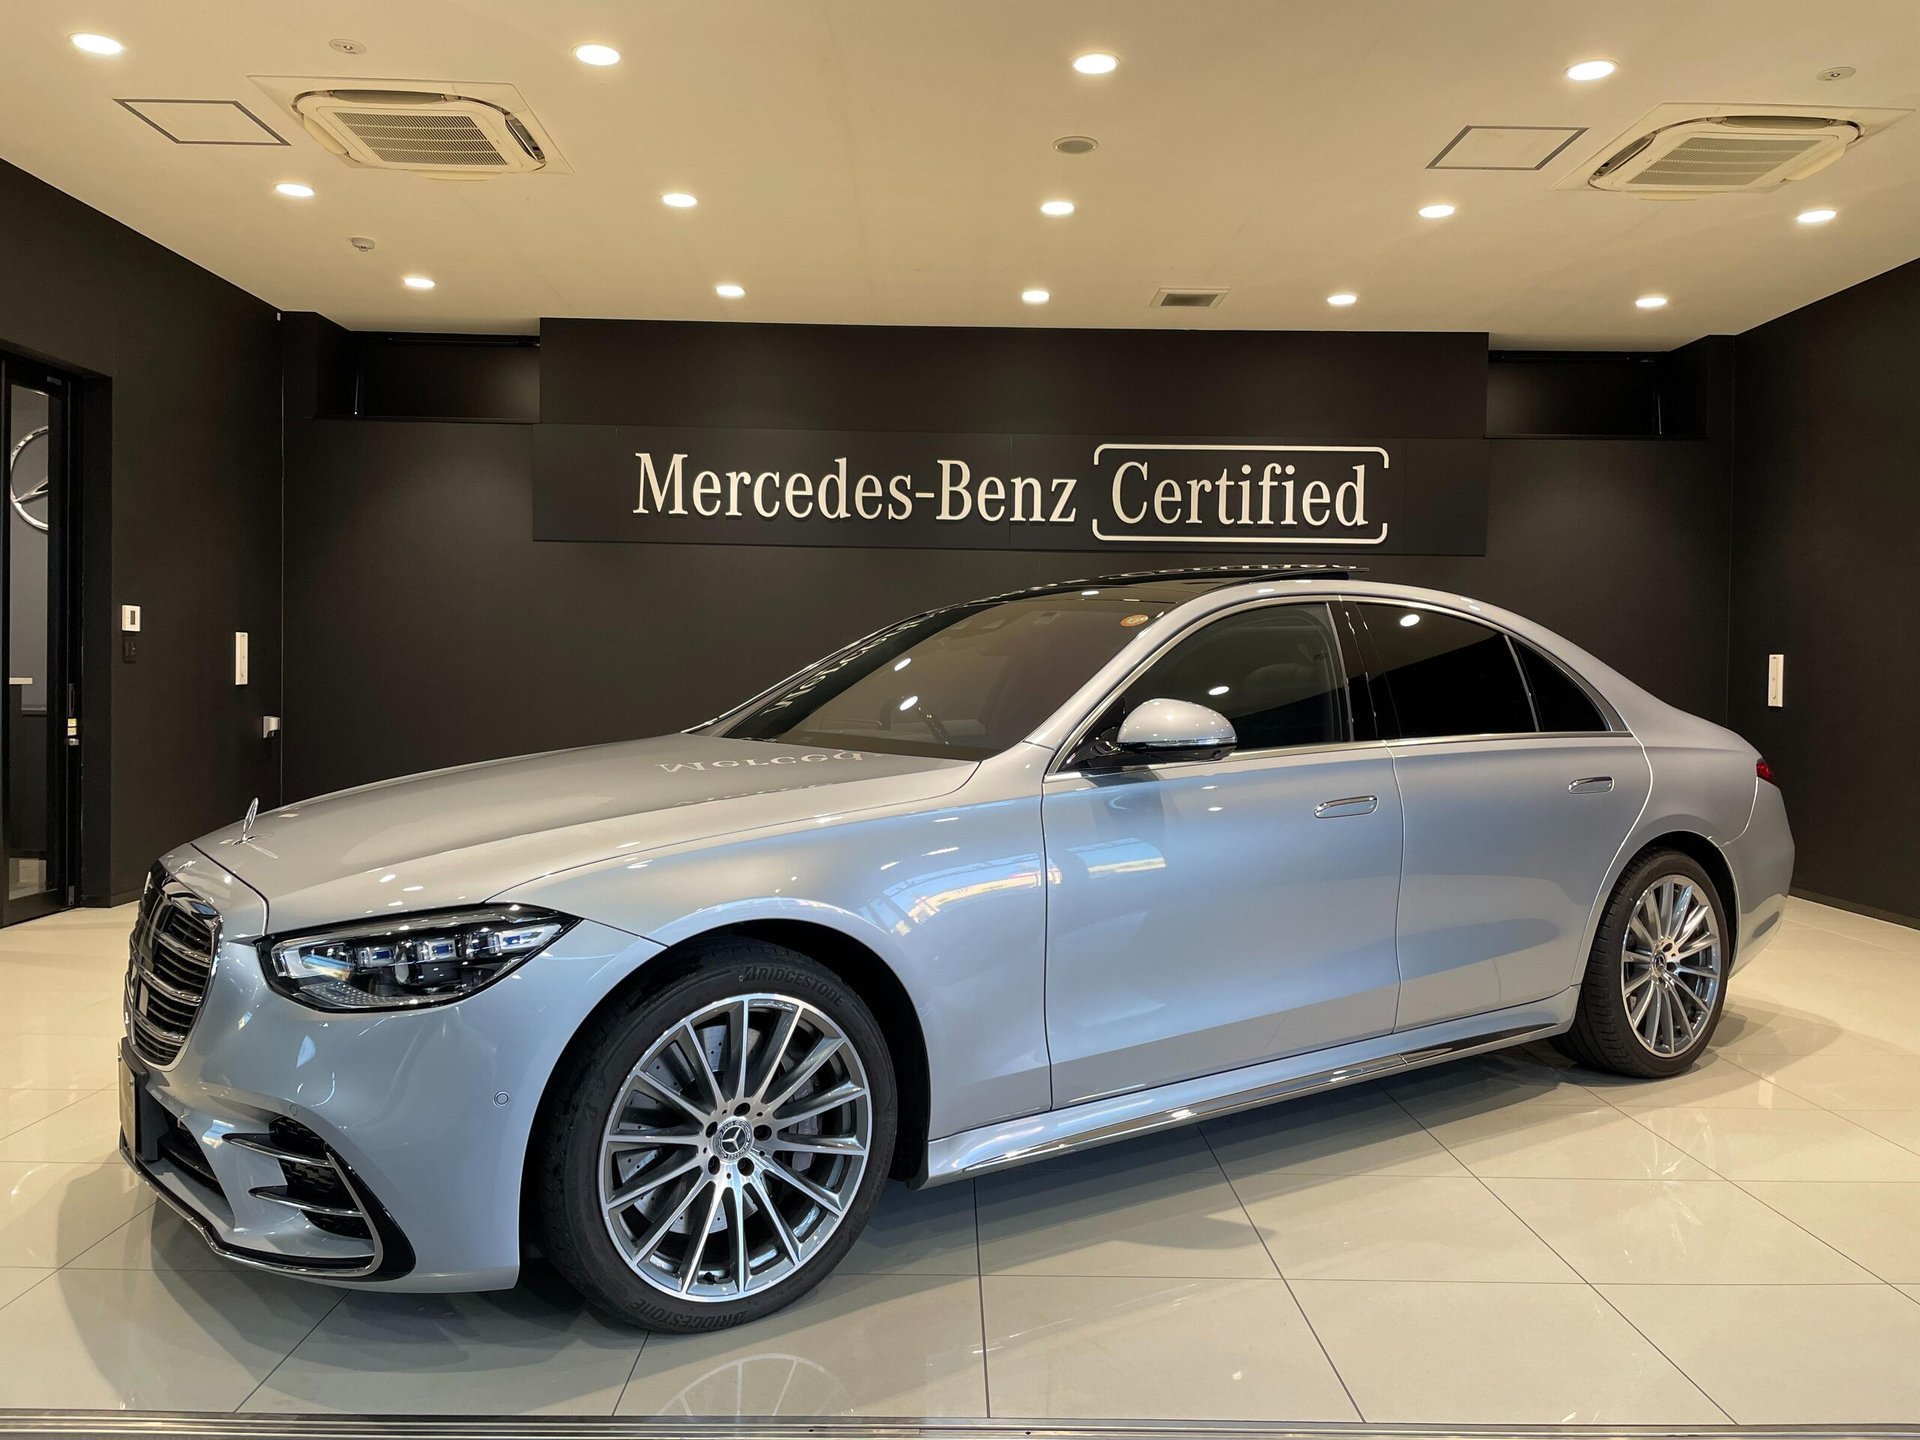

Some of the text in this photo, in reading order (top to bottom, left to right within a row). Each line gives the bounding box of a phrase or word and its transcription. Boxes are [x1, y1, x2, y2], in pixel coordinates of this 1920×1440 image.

[633, 453, 1368, 527] Mercedes-Benz Certified
[743, 966, 844, 1006] BRIDGESTONE
[630, 1297, 747, 1329] BRIDGESTONE
